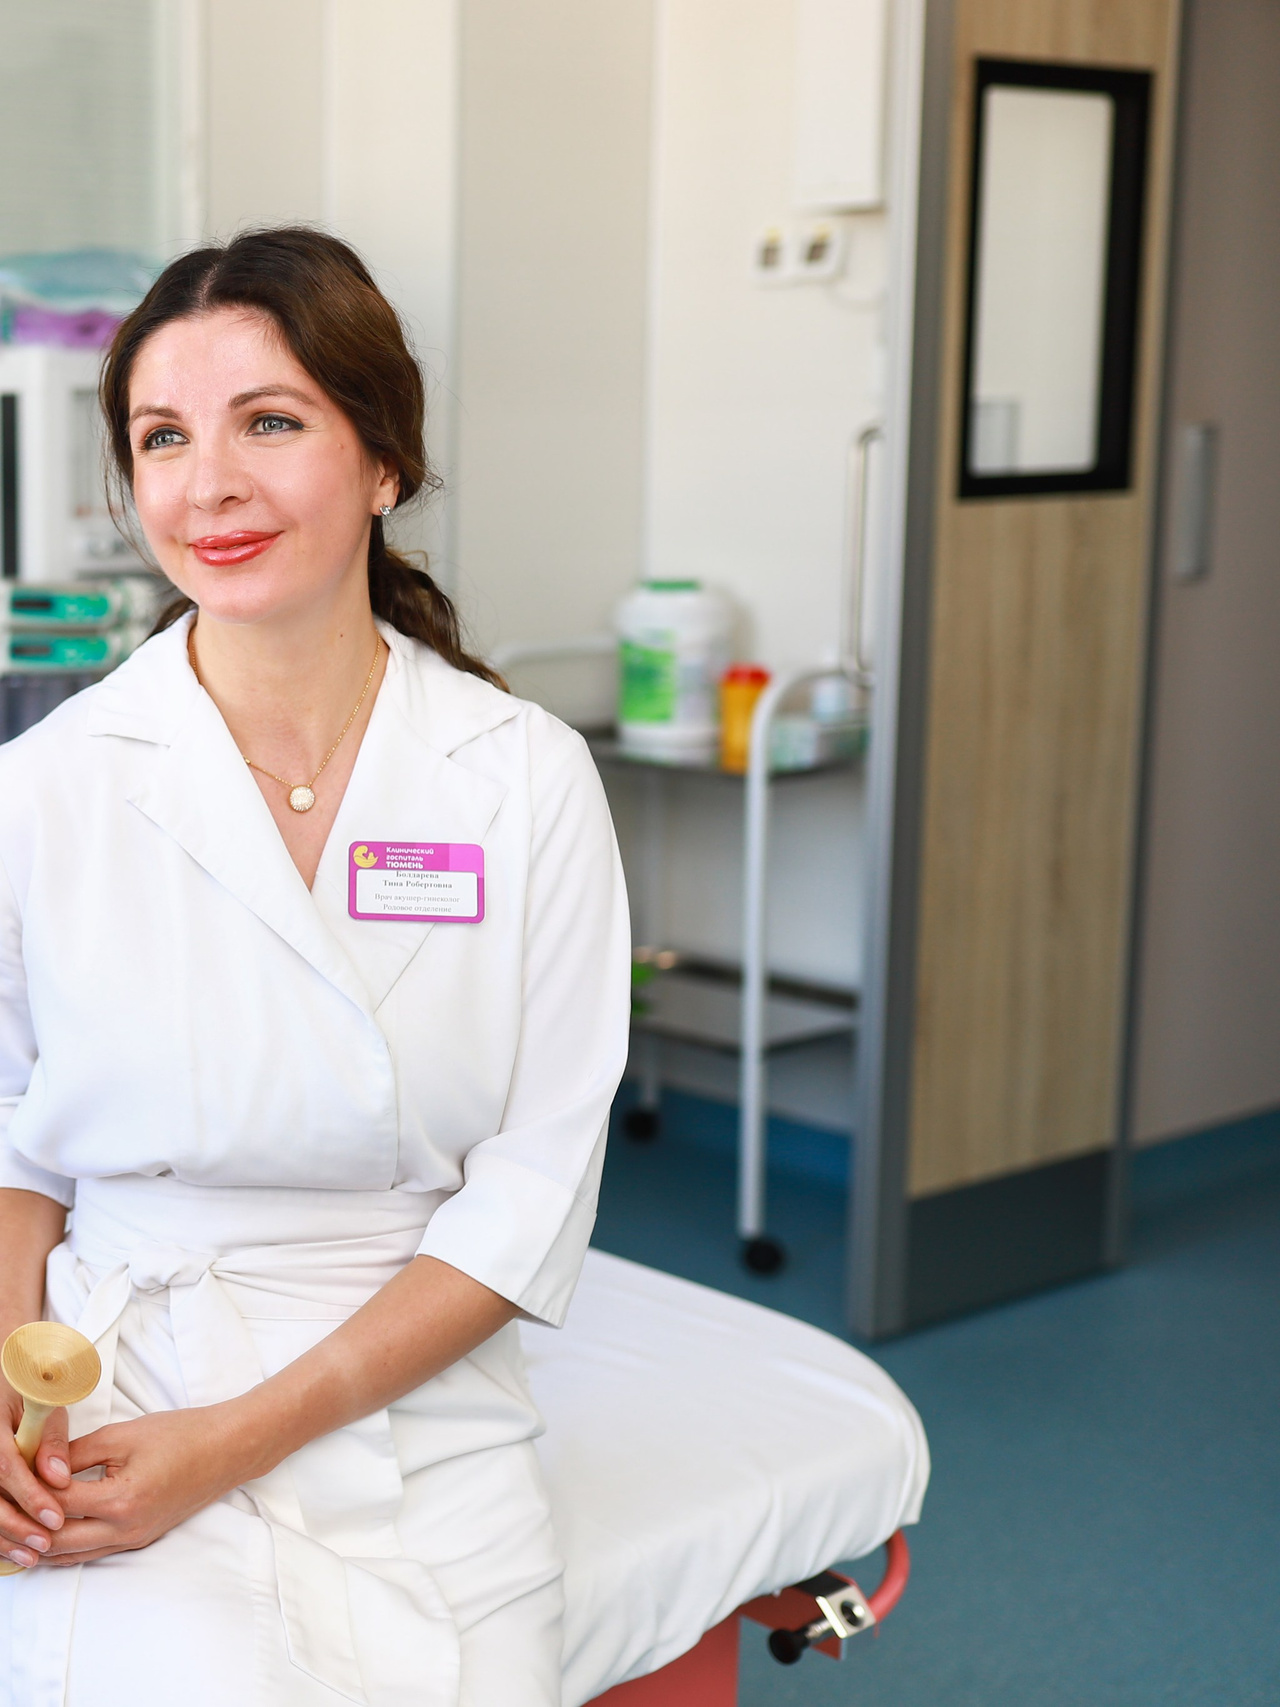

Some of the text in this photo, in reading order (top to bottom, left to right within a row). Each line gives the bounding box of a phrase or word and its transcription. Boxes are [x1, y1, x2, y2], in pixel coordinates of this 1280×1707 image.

[386, 847, 434, 855] Клинический
[386, 854, 423, 862] госпиталь
[386, 861, 424, 869] ТЮМЕНЬ
[382, 879, 452, 889] Тина Робертовна
[374, 893, 460, 903] Врач акушер-гинеколог
[383, 903, 452, 912] Родовое отделение
